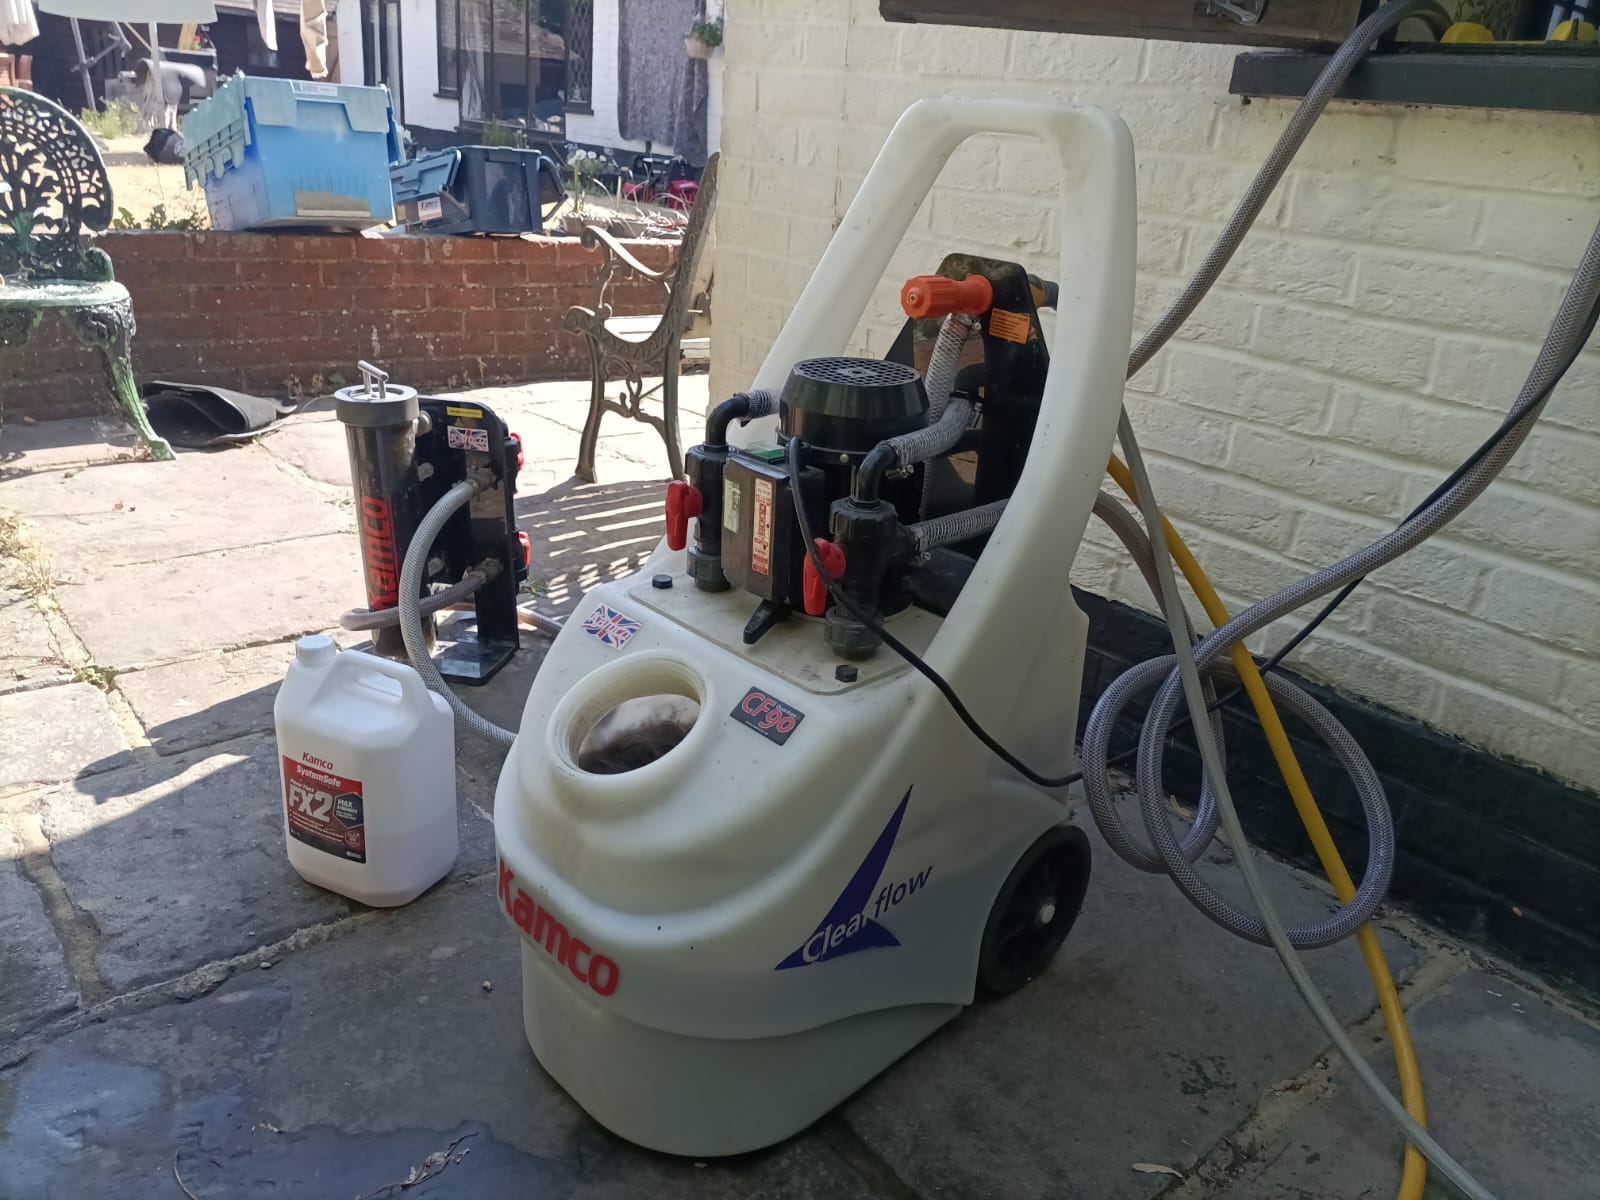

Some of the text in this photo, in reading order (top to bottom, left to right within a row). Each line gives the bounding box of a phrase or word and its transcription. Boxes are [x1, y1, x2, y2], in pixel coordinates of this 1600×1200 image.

[742, 692, 796, 733] CF90
[296, 765, 341, 787] SystemSafe
[302, 752, 333, 770] Kamco
[289, 784, 333, 823] FX2
[337, 798, 353, 808] MAX
[499, 855, 620, 997] Kamco
